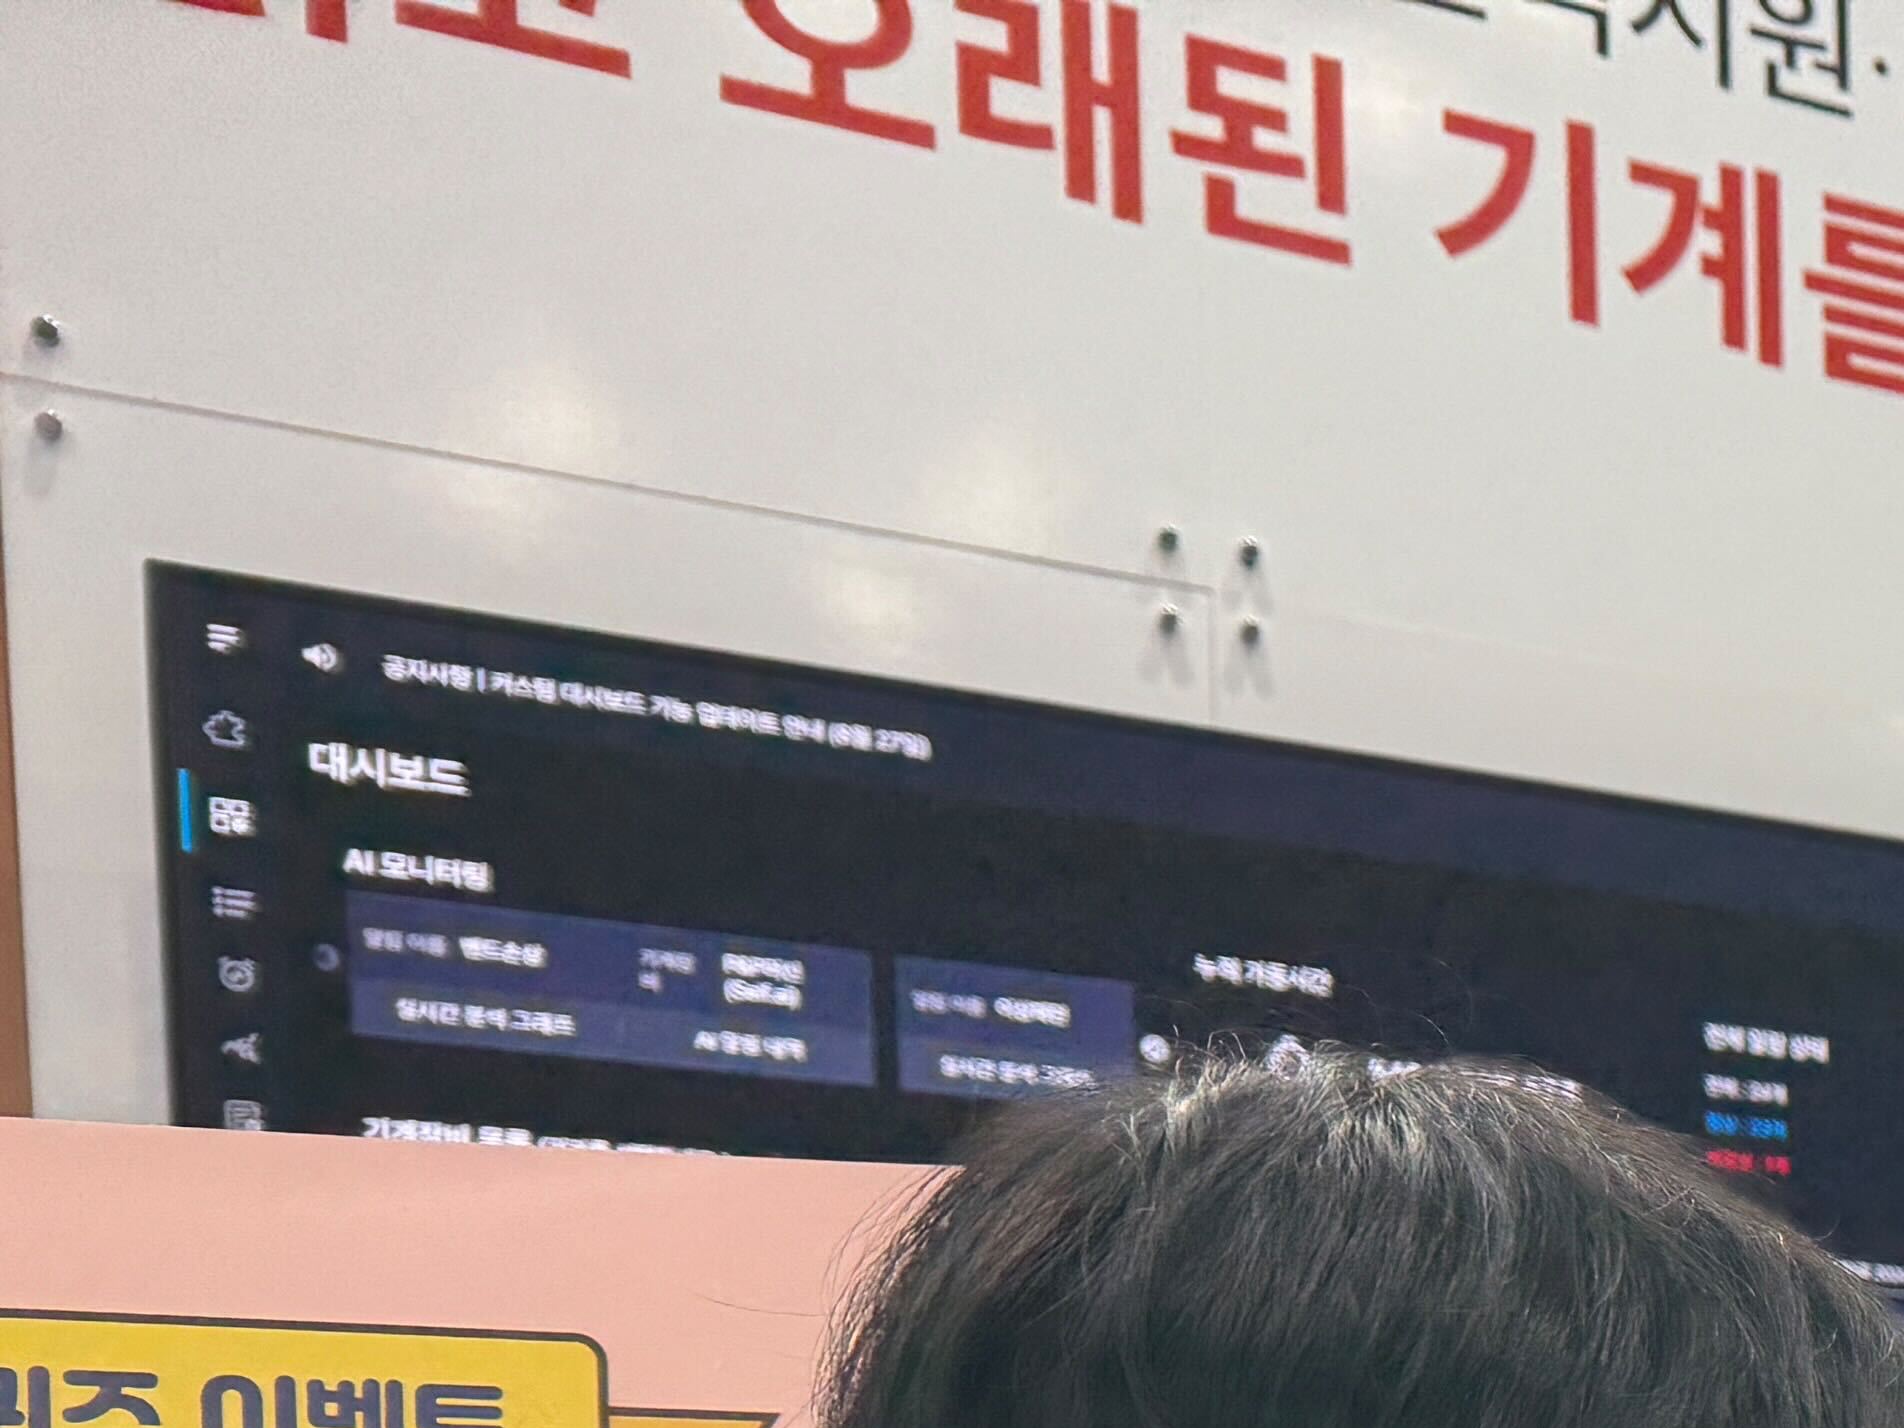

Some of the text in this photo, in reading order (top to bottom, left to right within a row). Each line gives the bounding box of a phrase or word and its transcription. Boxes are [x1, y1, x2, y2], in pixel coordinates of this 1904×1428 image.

[718, 0, 1354, 268] 오래된
[381, 653, 473, 692] 공지사항
[488, 668, 558, 705] 커스텀
[558, 681, 648, 716] 대시보드
[649, 693, 694, 725] 기능
[695, 700, 782, 737] 업데이트
[308, 740, 471, 799] 대시보드
[343, 847, 494, 893] AI 모니터링
